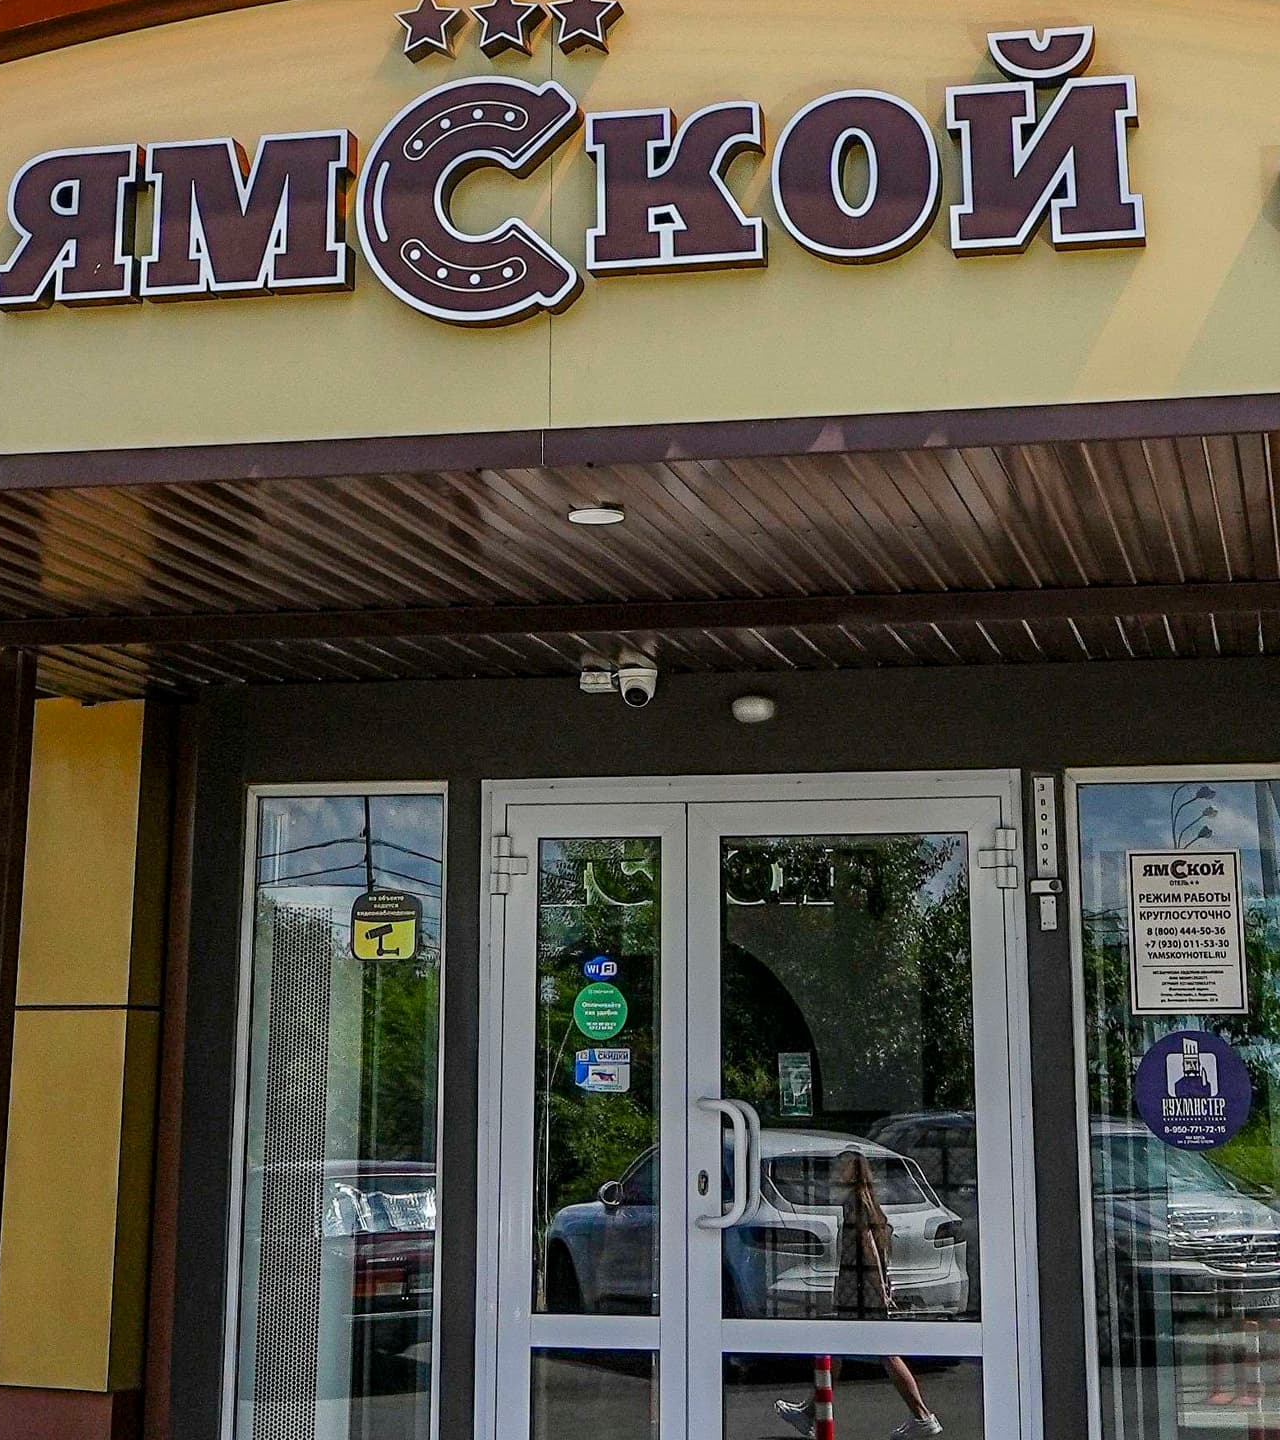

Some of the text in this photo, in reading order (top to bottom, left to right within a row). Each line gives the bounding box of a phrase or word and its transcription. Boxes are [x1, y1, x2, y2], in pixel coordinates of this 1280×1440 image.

[1142, 859, 1225, 879] ЯМСКОЙ
[1139, 892, 1231, 903] РЕЖИМ РАБОТЫ
[1139, 910, 1232, 921] КРУГЛОСУТОЧНО
[1146, 926, 1226, 936] 8 (800) 444-50-36
[1144, 940, 1230, 949] +7 (930) 011-53-30
[1147, 951, 1227, 959] YAMSKOYHOTEL.RU
